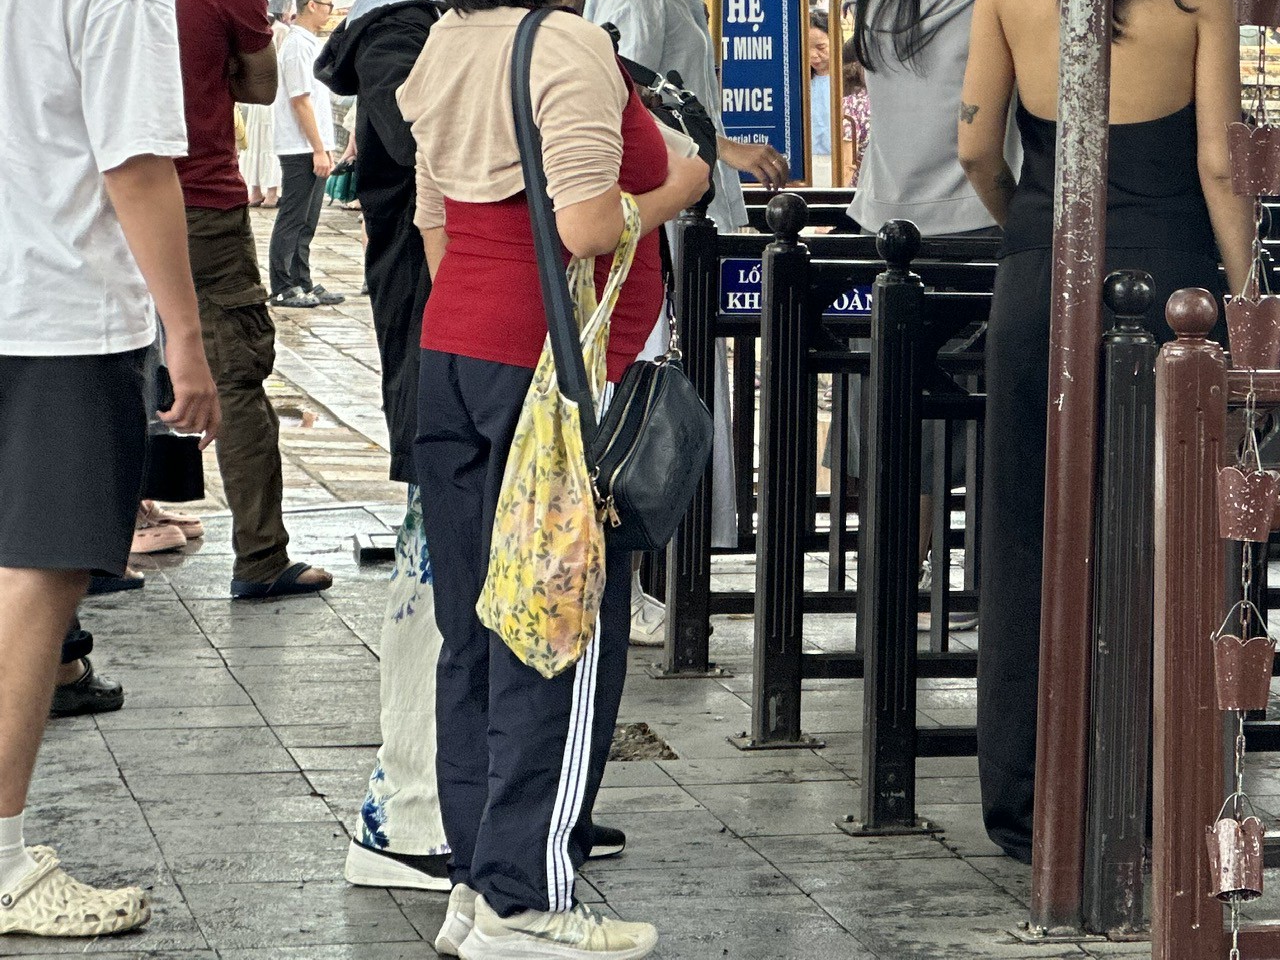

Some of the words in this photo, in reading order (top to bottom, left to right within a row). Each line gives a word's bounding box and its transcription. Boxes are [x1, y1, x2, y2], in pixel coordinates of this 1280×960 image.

[733, 36, 772, 60] MINH
[753, 133, 769, 146] City
[738, 263, 762, 284] LỐ
[726, 292, 762, 310] KH
